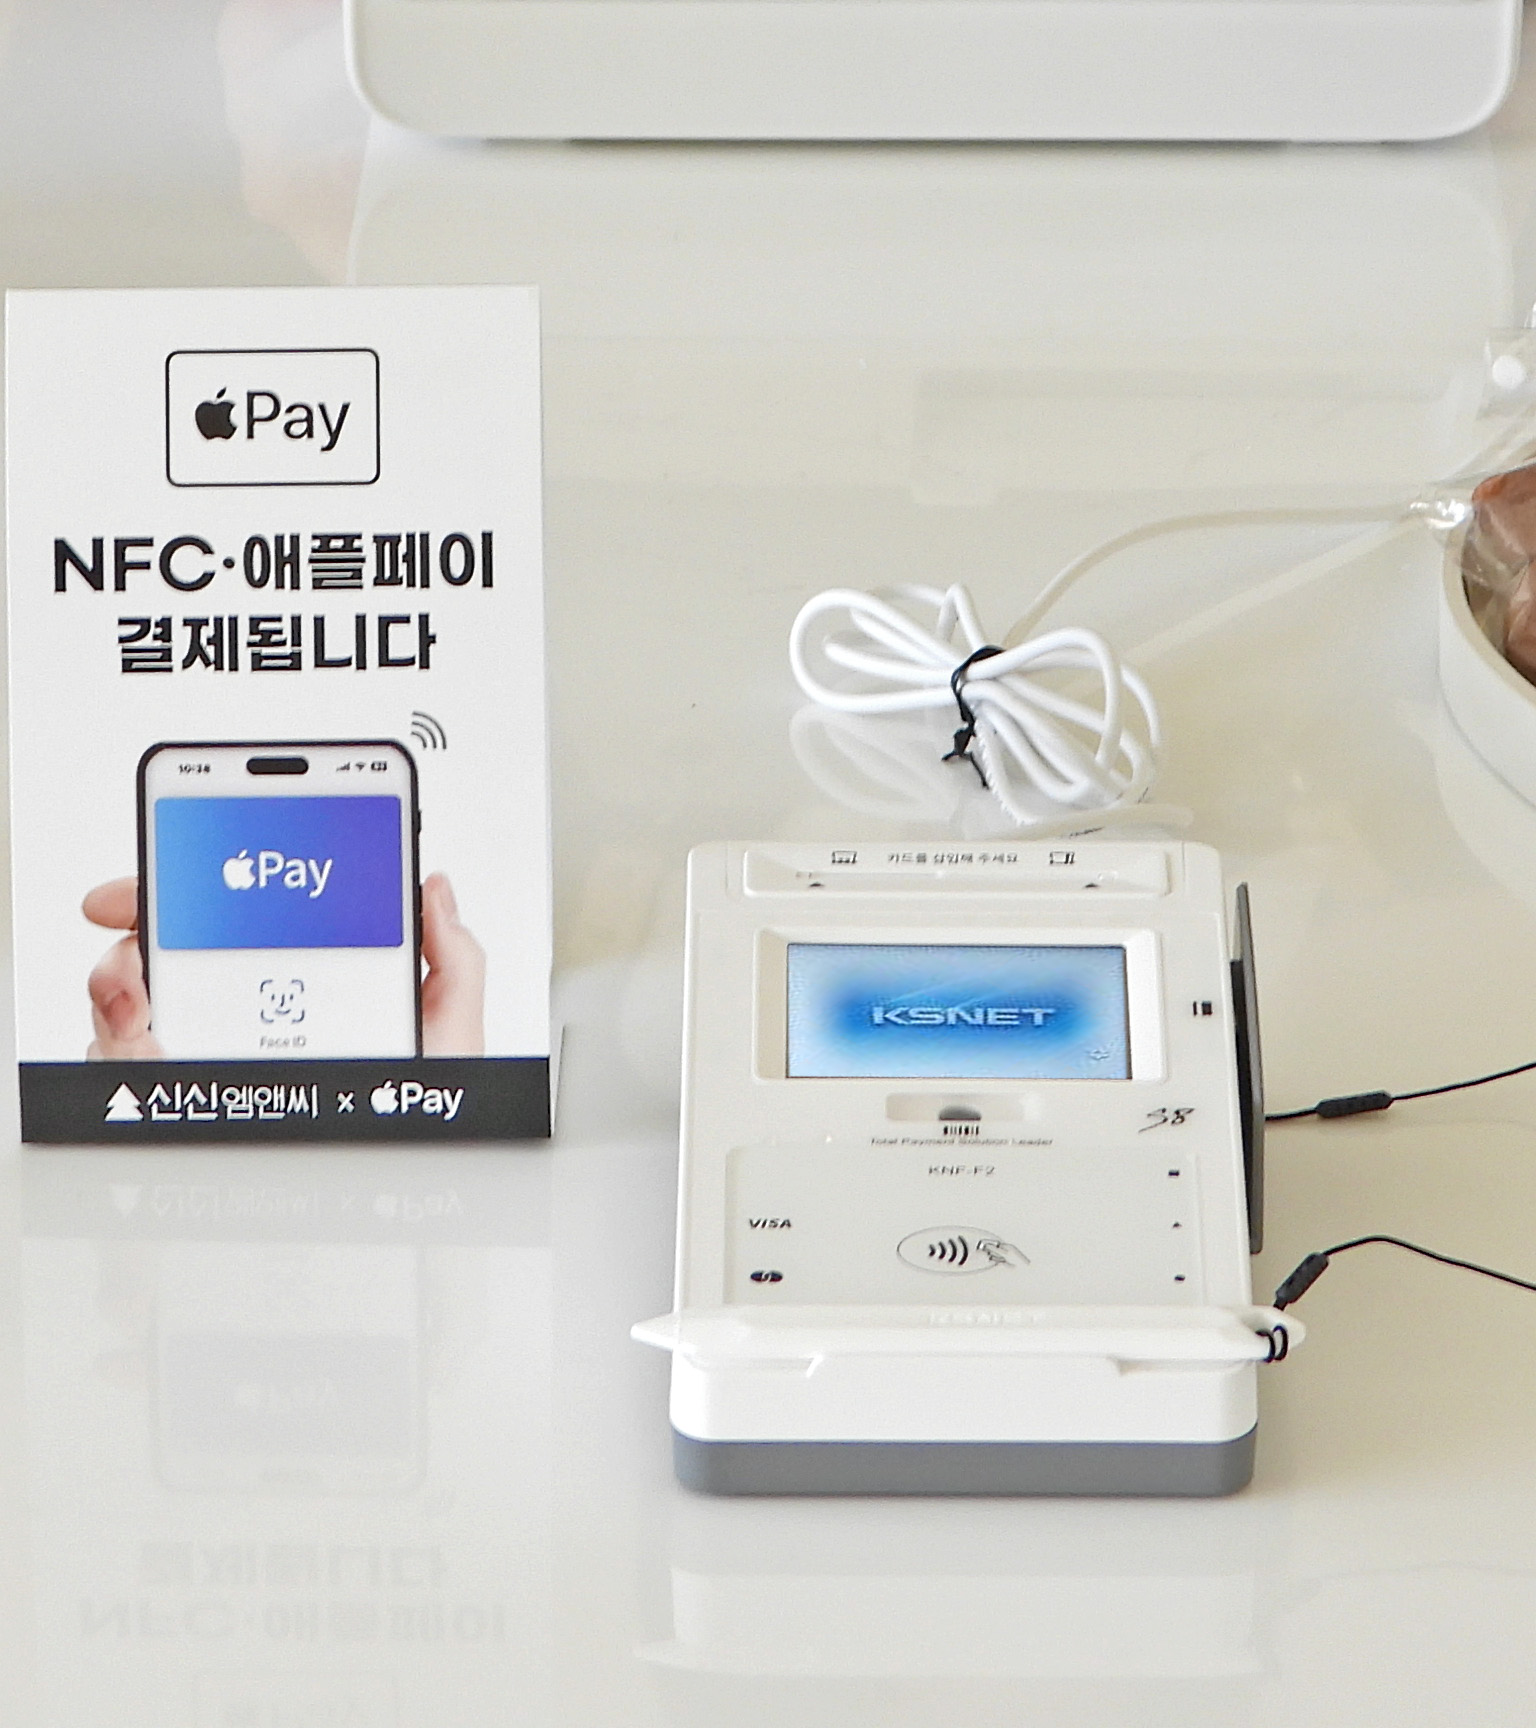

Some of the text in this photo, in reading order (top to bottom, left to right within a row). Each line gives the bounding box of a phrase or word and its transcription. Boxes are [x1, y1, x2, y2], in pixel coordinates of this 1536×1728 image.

[245, 390, 352, 452] Pay
[53, 531, 495, 593] NFC·애플페이
[117, 614, 436, 674] 결제됩니다
[258, 849, 334, 899] Pay
[871, 1005, 1057, 1027] KSNET
[259, 1035, 290, 1050] Face
[148, 1080, 320, 1122] 신신엠앤씨
[400, 1080, 465, 1122] Pay
[748, 1217, 793, 1230] VISA
